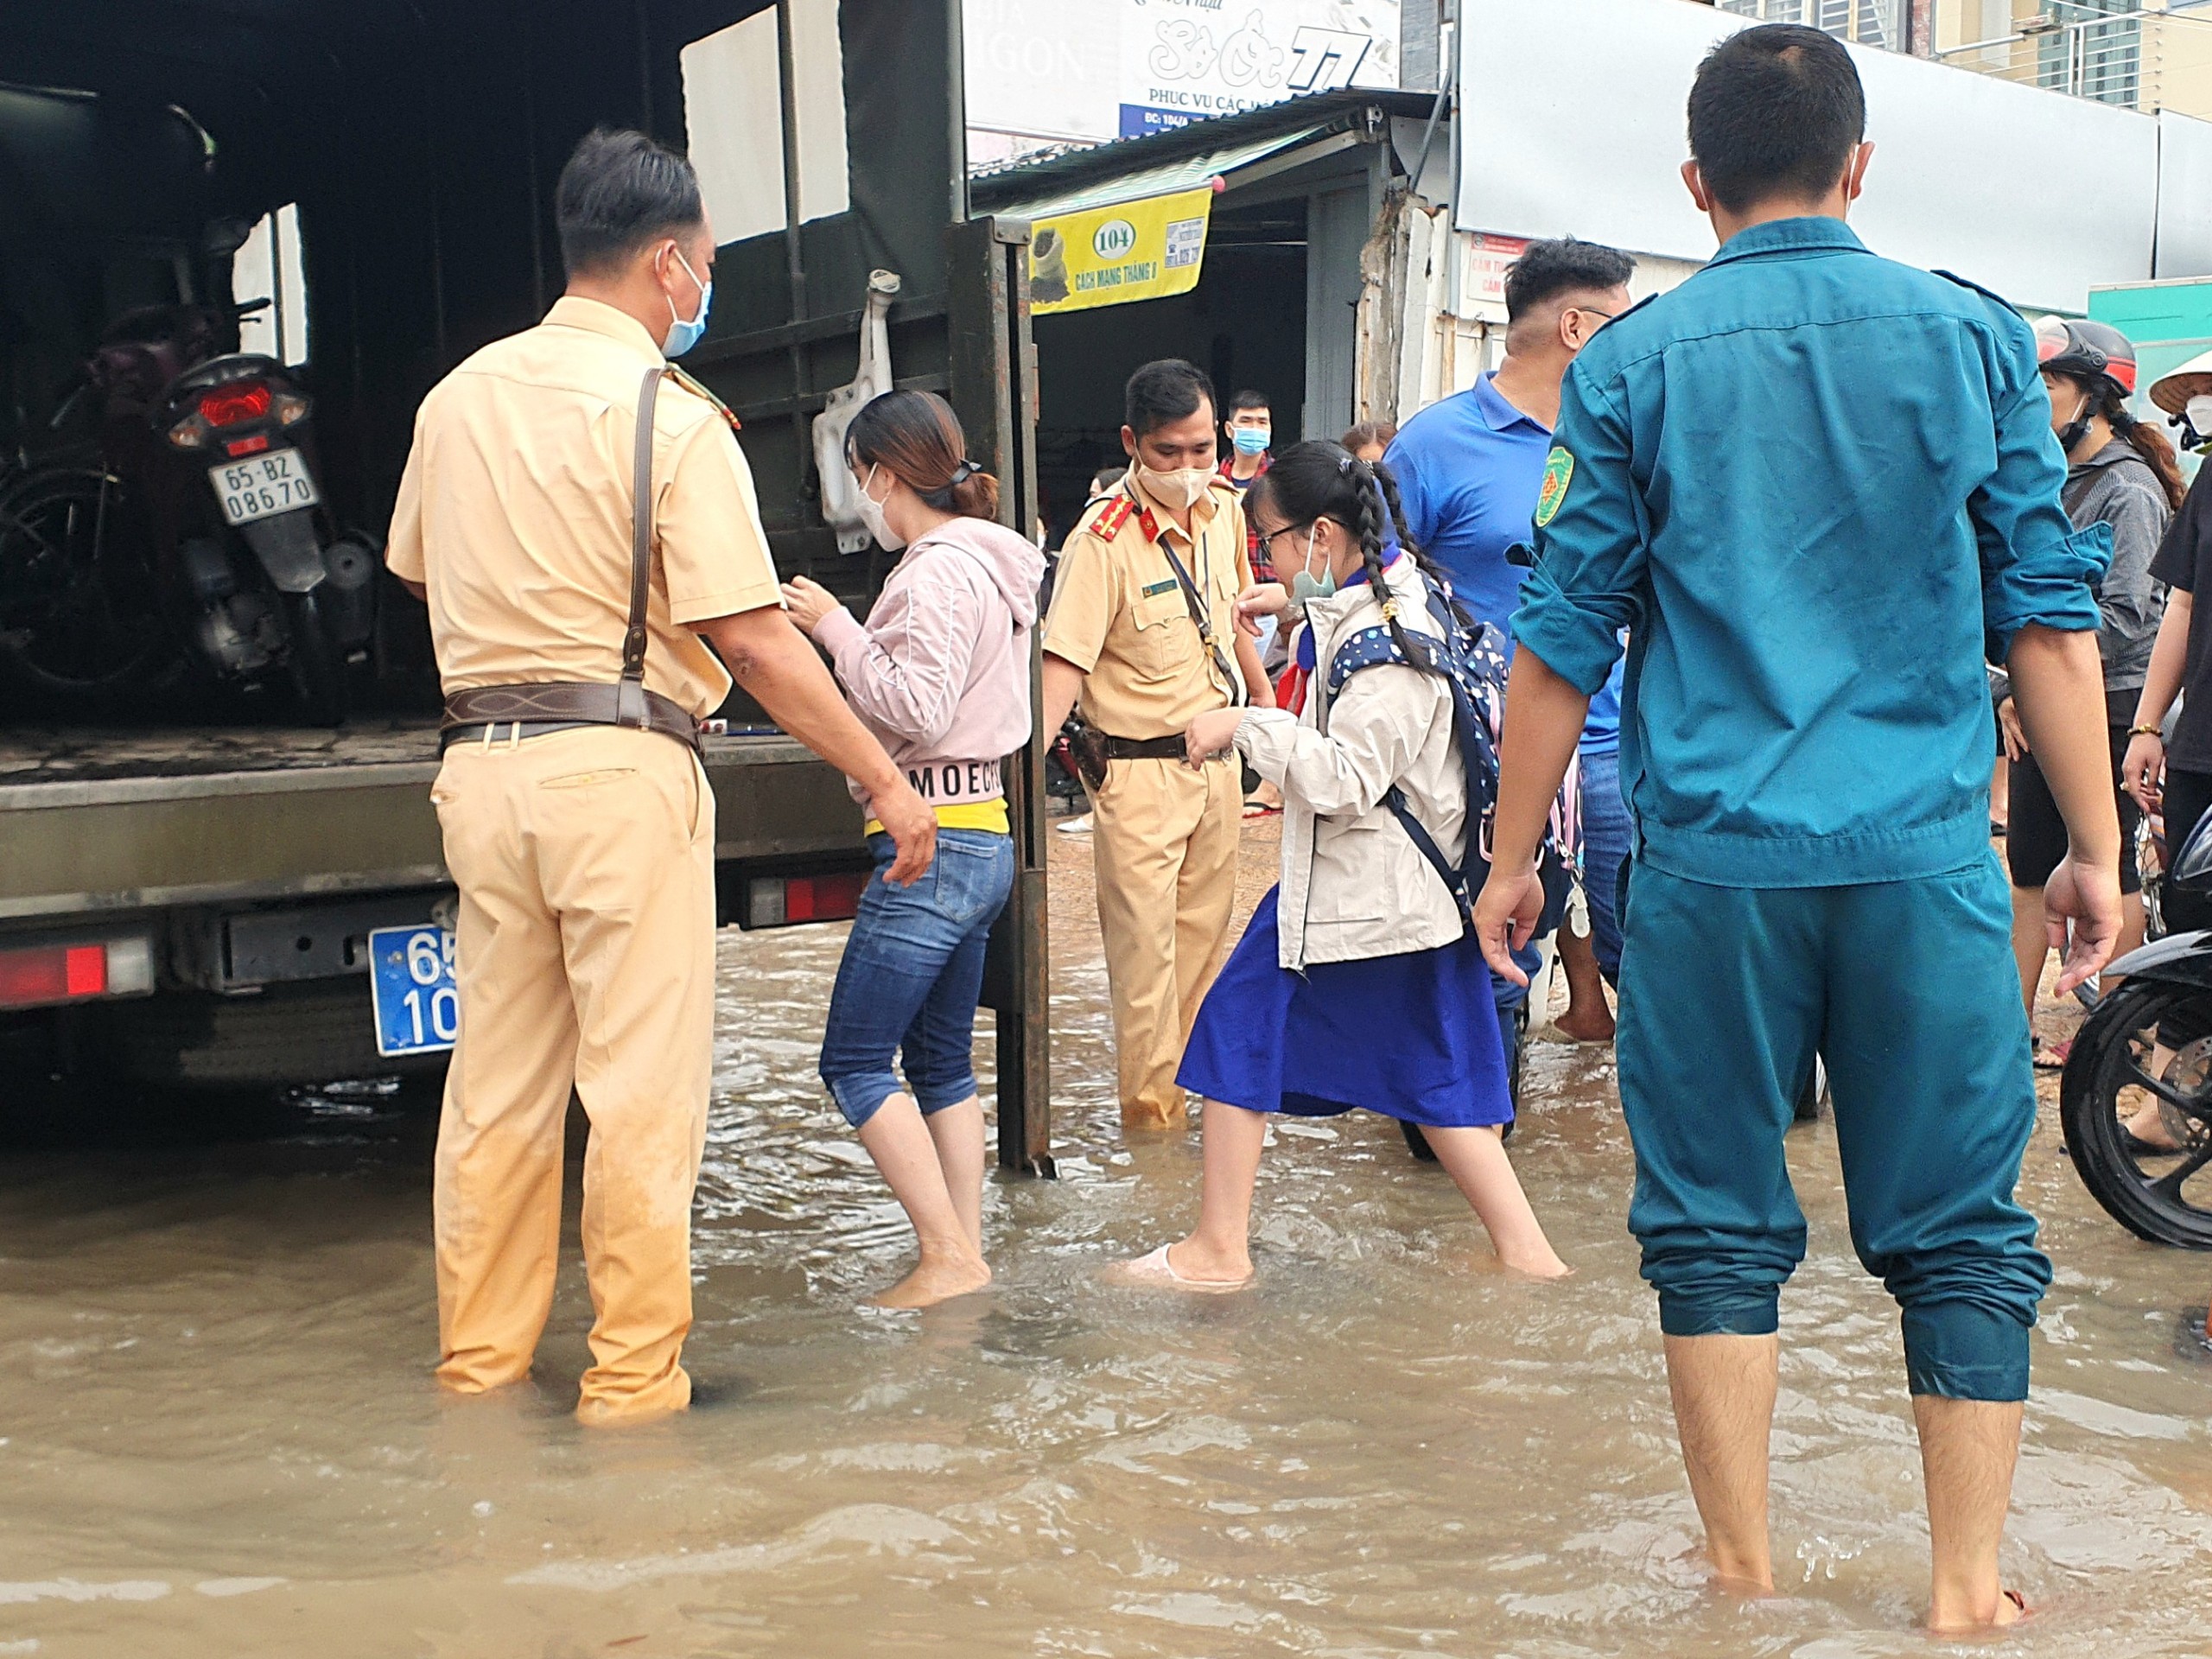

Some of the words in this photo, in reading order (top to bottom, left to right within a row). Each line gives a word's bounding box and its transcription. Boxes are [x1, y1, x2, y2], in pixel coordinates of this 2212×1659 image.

[1286, 26, 1372, 91] 77
[1193, 93, 1211, 111] VỤ
[1100, 227, 1128, 251] 104
[404, 988, 459, 1045] 10
